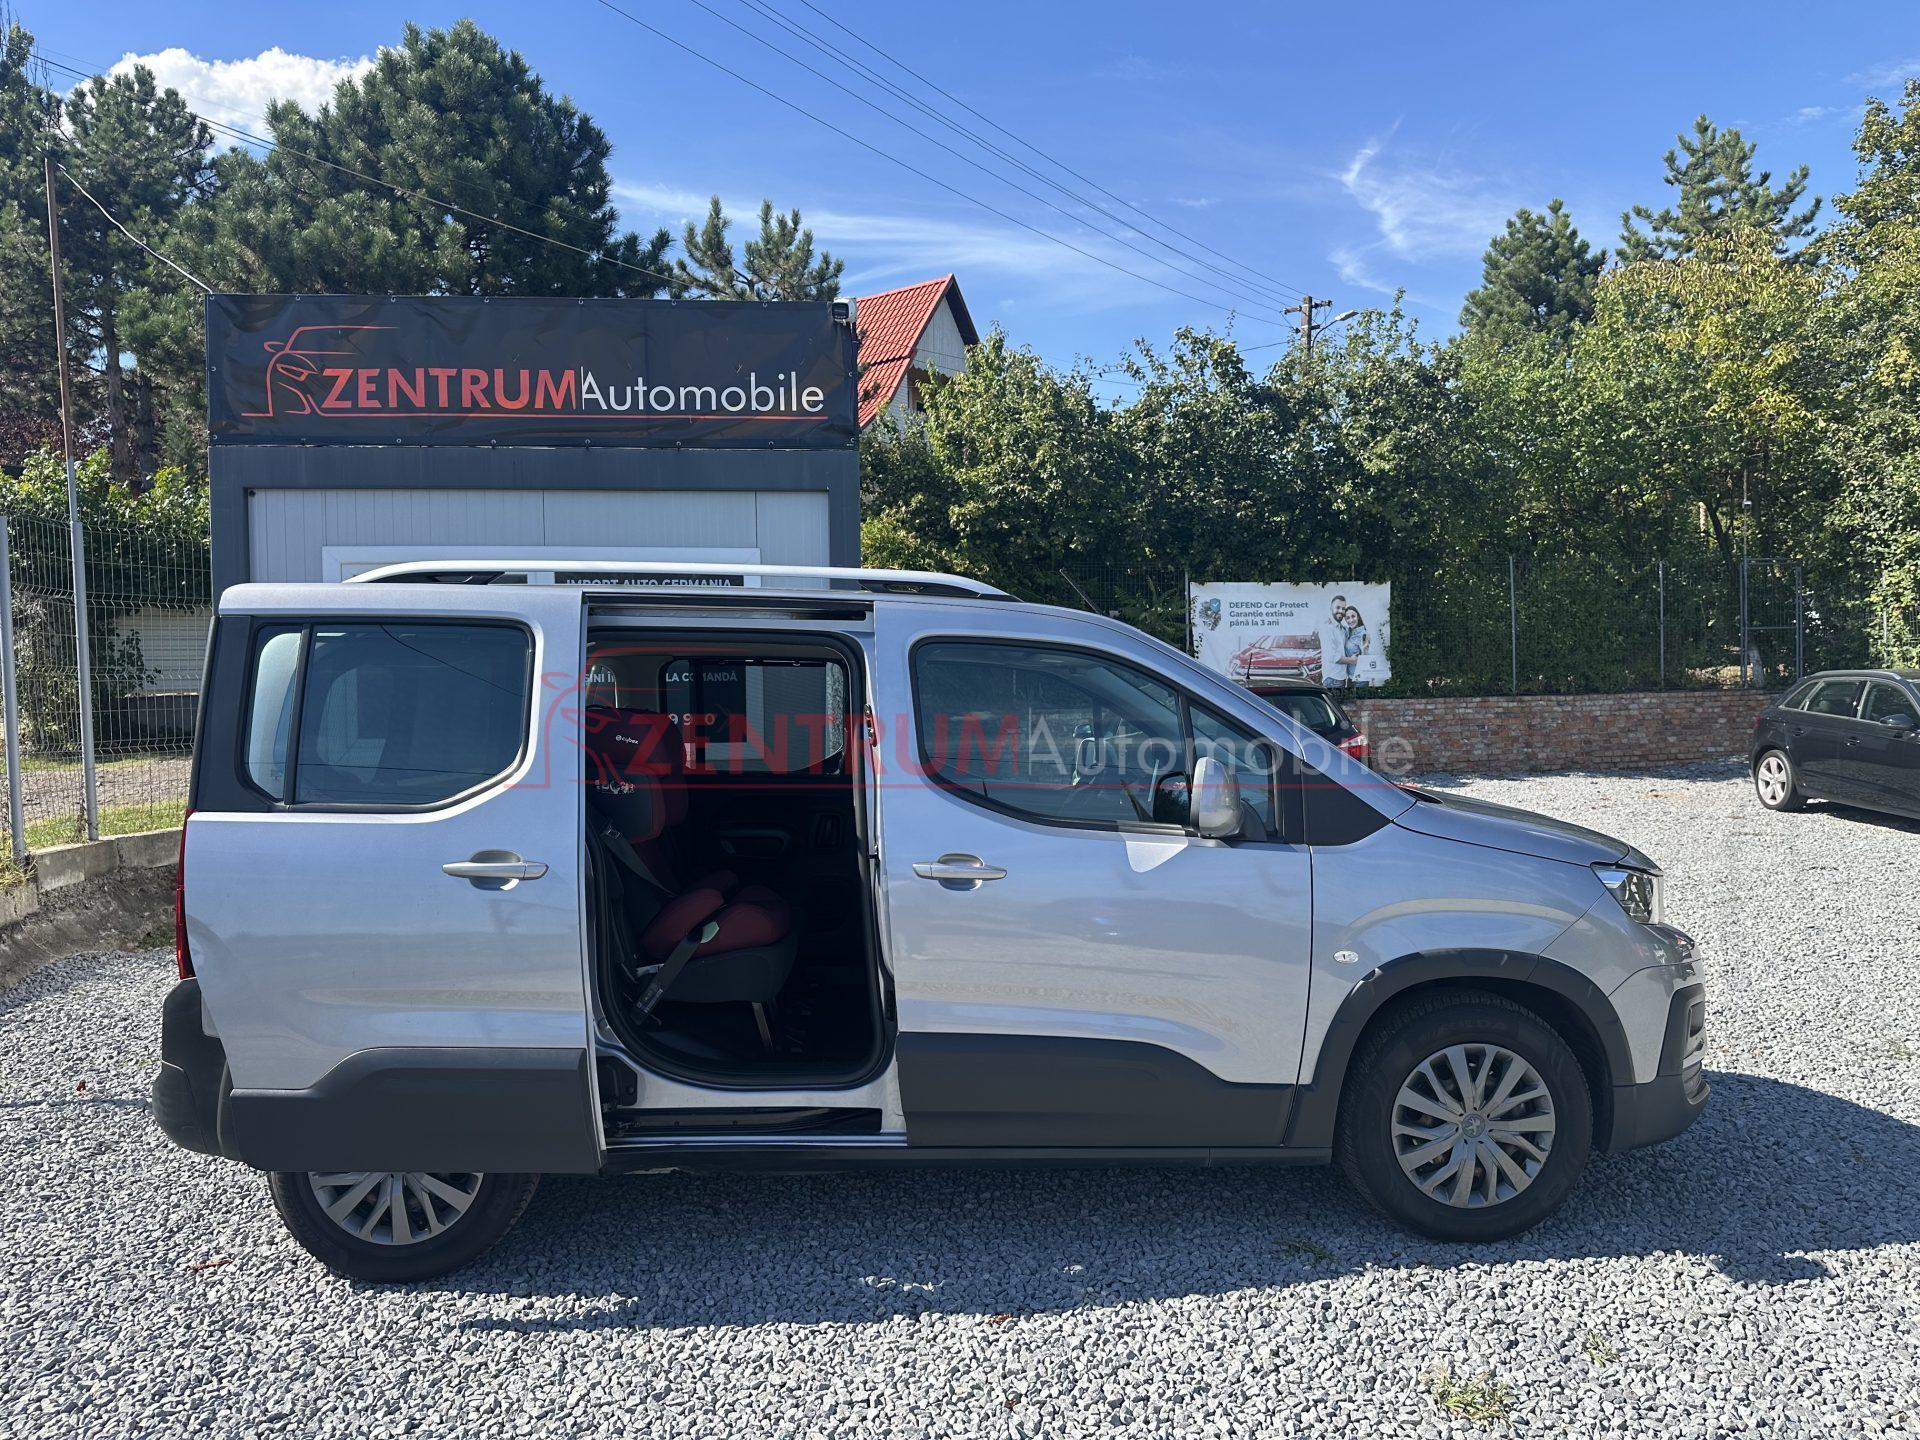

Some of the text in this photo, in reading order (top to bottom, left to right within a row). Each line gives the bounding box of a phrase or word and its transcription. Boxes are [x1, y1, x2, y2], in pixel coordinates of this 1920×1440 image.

[321, 366, 824, 412] ZENTRUM Automobile
[1229, 601, 1309, 609] DEFEND Car Protect
[1251, 619, 1259, 627] la
[1260, 619, 1266, 627] 3
[1267, 619, 1280, 627] ani
[665, 672, 680, 682] LA
